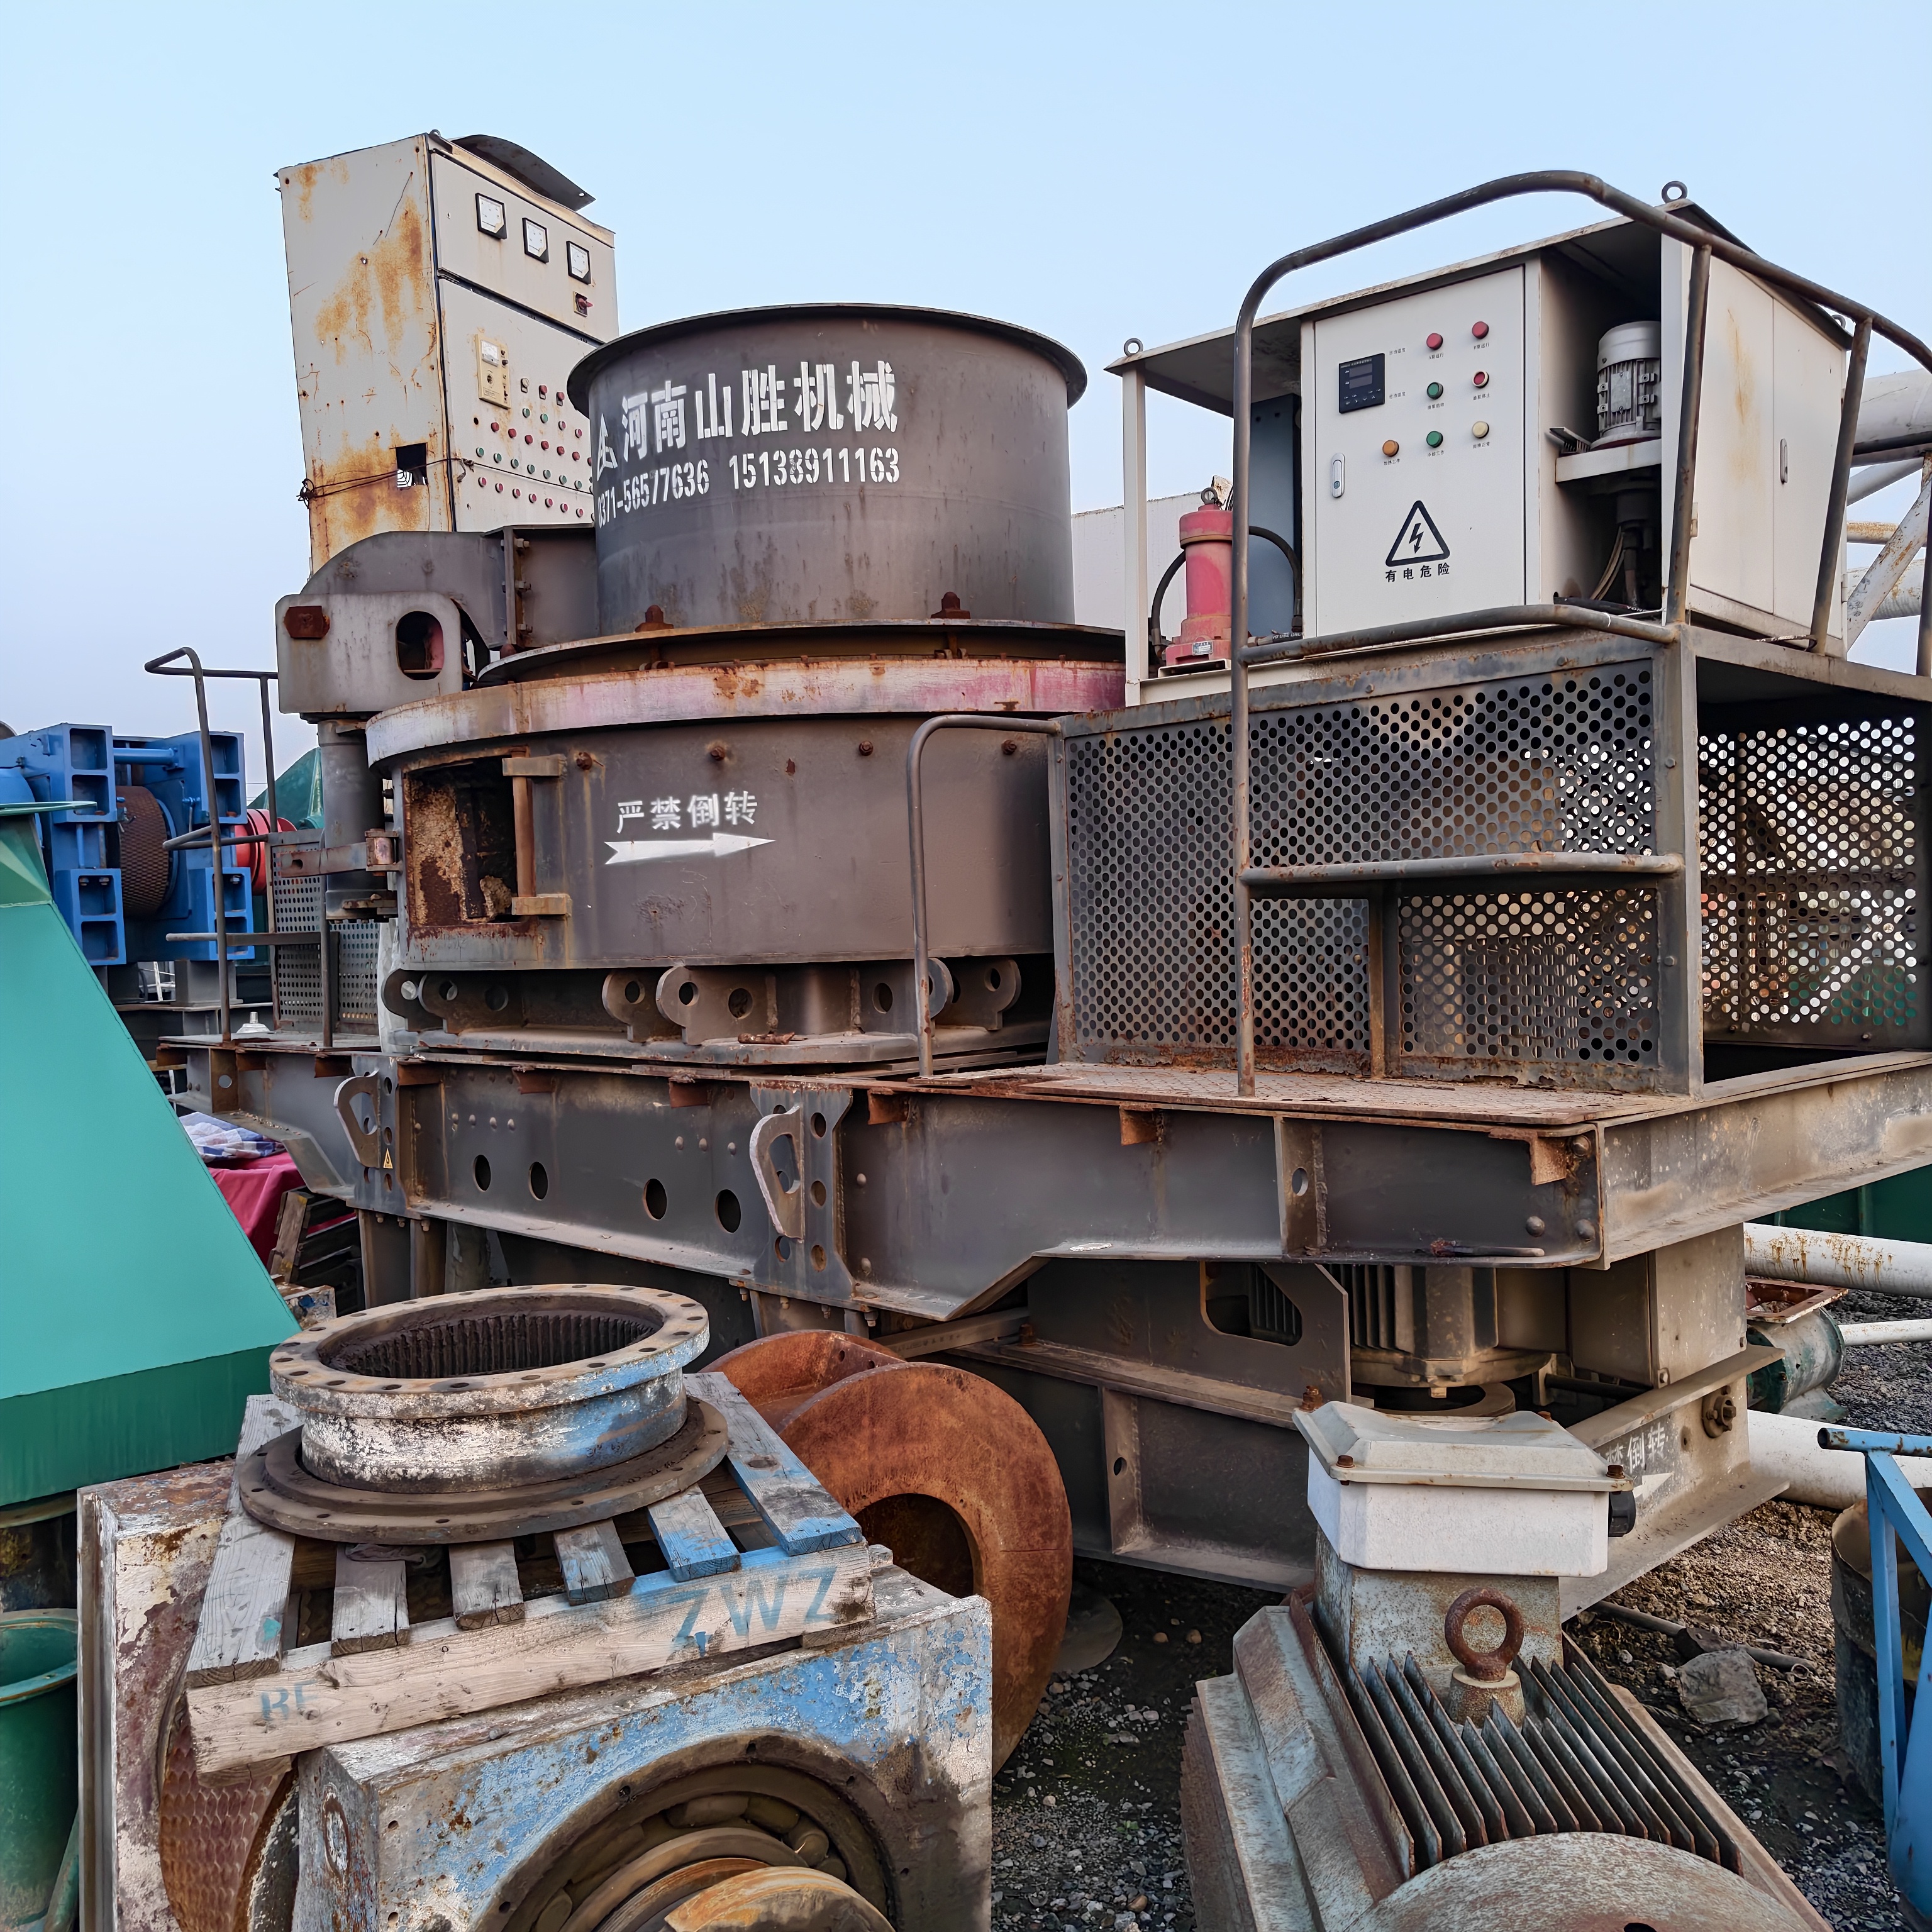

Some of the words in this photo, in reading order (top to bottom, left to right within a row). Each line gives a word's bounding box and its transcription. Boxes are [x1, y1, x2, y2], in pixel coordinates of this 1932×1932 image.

[622, 361, 897, 462] 河南山胜机械
[598, 459, 709, 528] 0371-56577636
[729, 447, 899, 489] 15138911163
[1385, 562, 1450, 582] 有电危险
[617, 791, 757, 833] 严禁倒转
[660, 1565, 838, 1649] ZWZ
